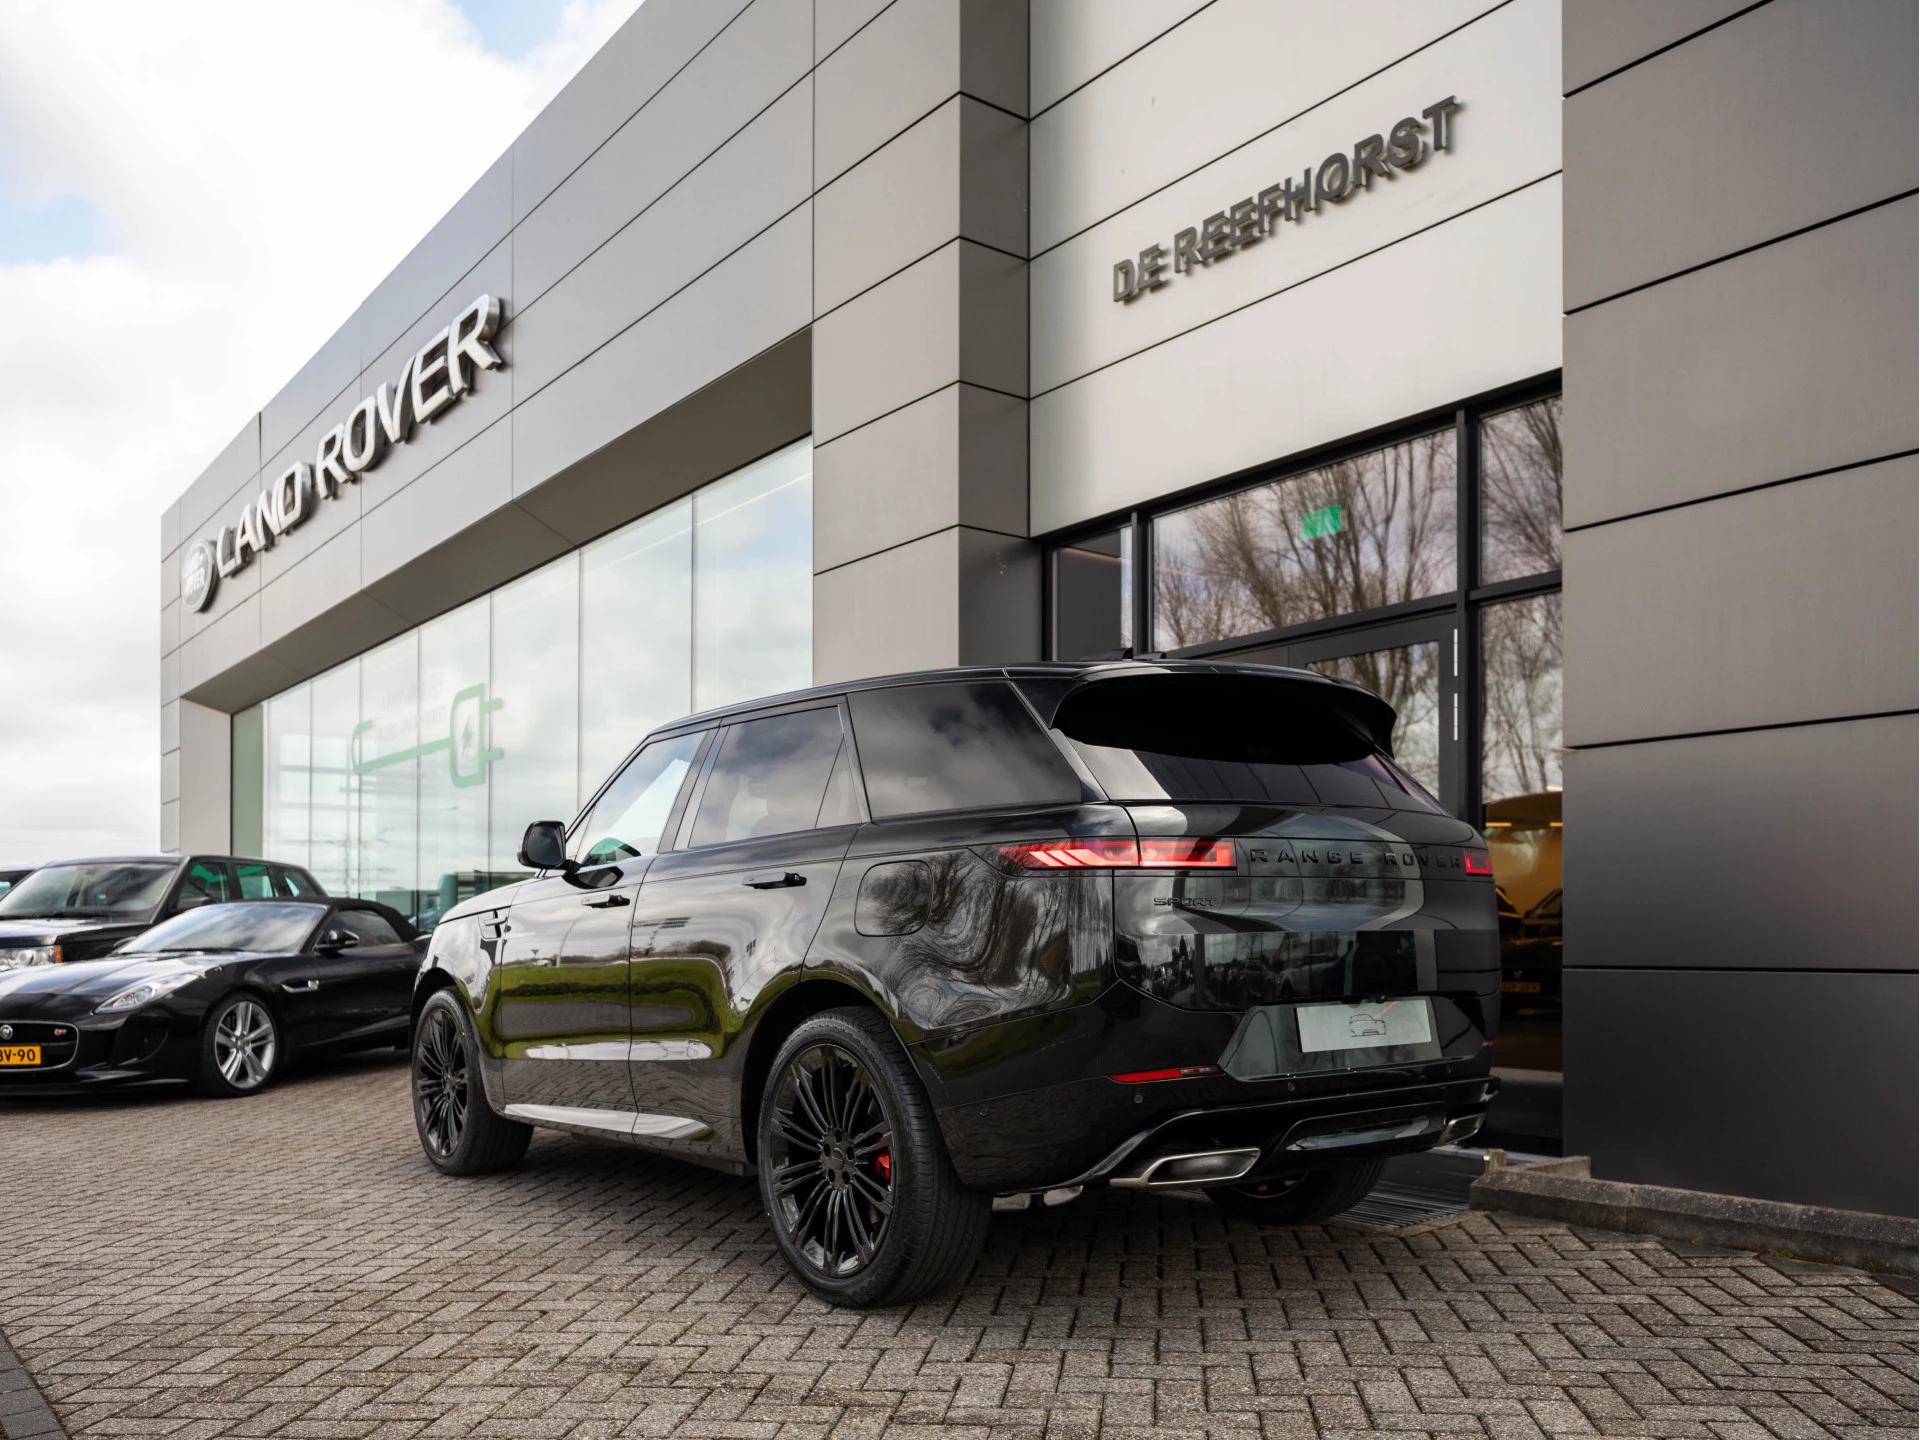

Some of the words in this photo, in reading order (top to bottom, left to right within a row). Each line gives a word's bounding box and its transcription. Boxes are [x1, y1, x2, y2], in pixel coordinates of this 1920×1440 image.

[1113, 243, 1168, 303] DE
[1174, 95, 1458, 273] REEFHORST
[216, 460, 313, 580] LAND
[315, 293, 502, 500] ROVER
[1153, 897, 1217, 907] SPORT
[1250, 848, 1364, 865] RANGE
[1384, 851, 1461, 869] ROVER
